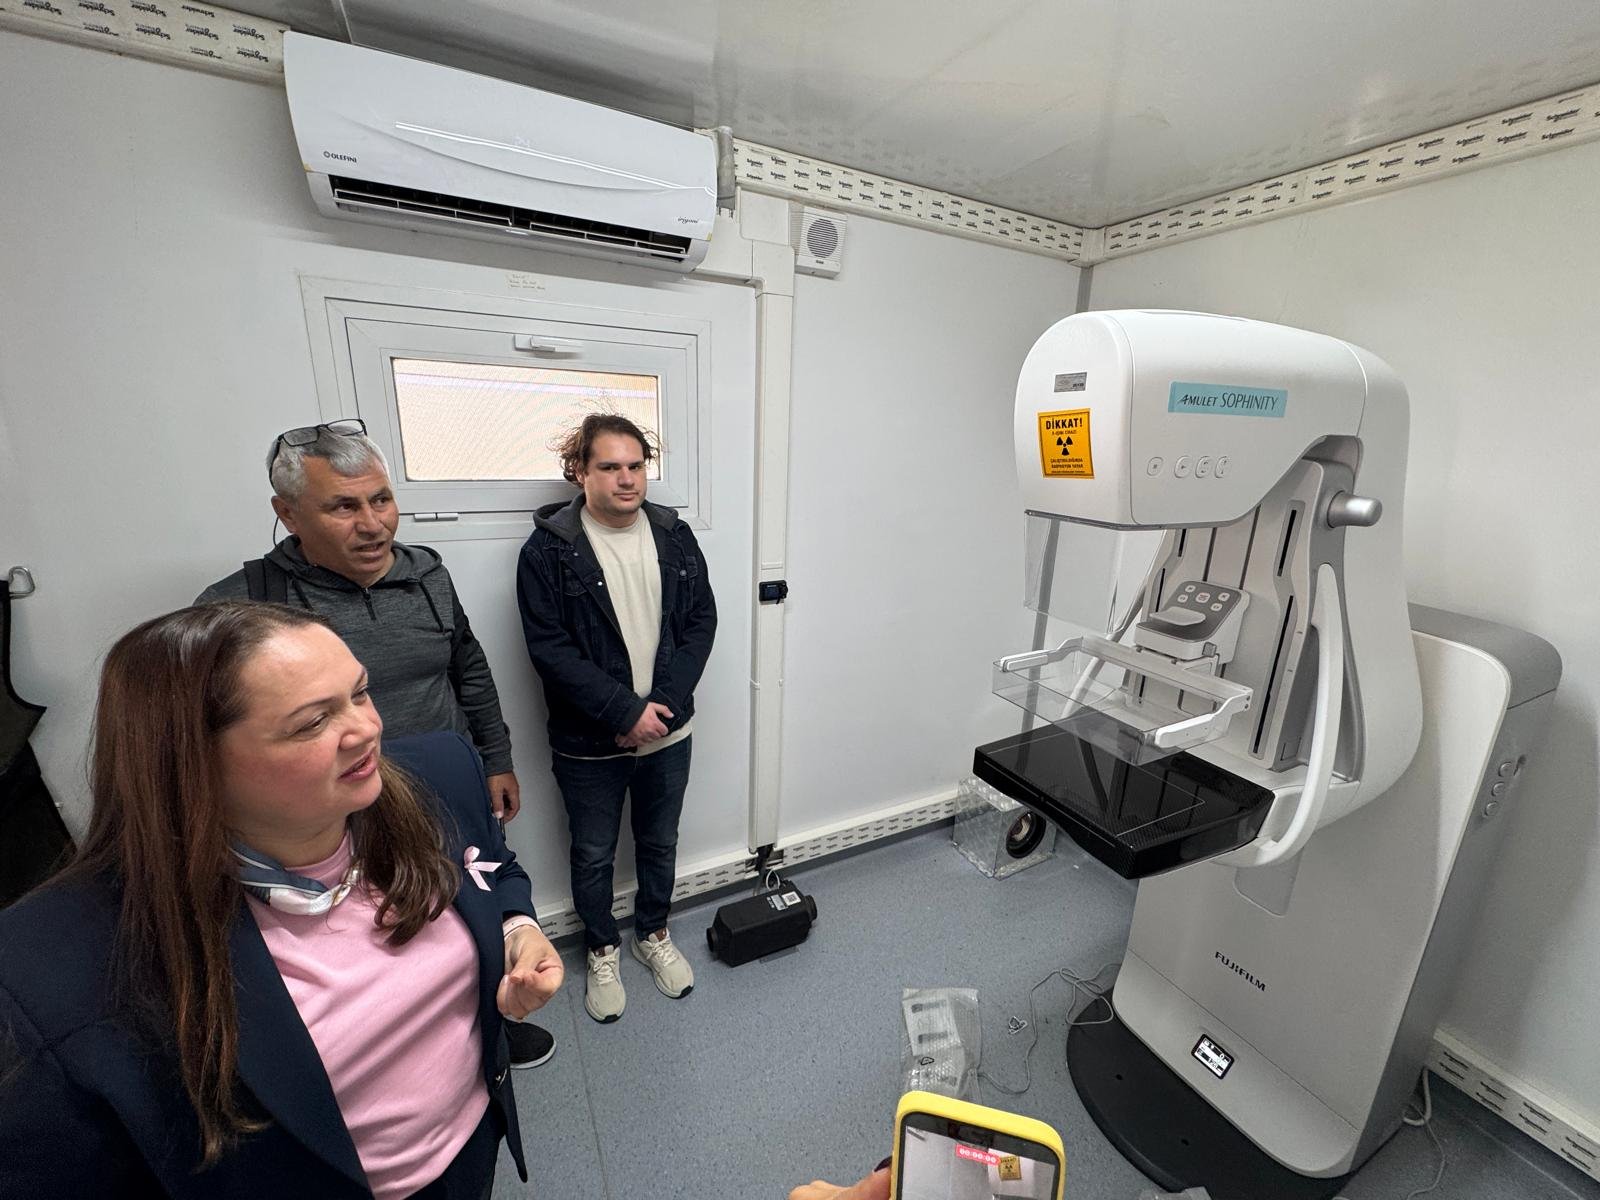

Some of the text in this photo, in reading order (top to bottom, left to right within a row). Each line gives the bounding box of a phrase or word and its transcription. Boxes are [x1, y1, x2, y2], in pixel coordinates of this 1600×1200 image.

[1178, 392, 1279, 411] AMULET SOPHINITY
[1046, 417, 1083, 430] DİKKAT!
[1215, 951, 1266, 991] FUJIFILM
